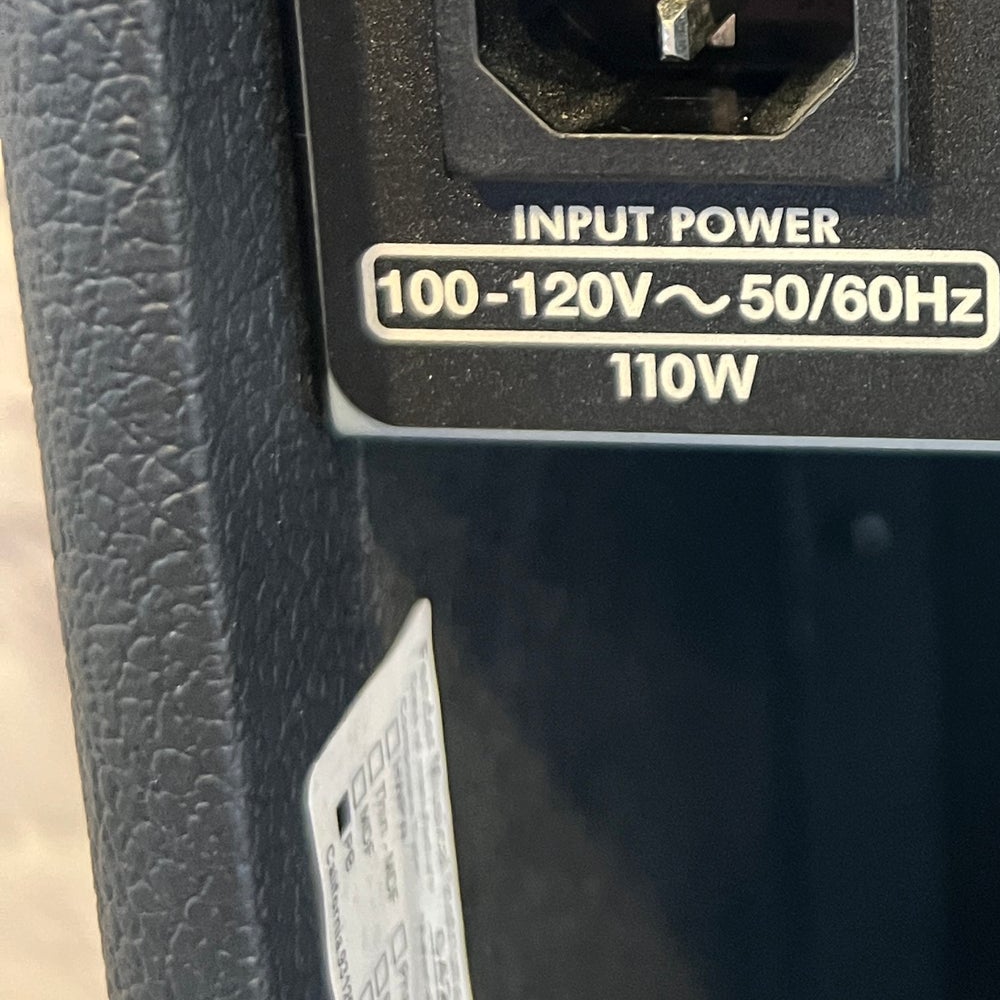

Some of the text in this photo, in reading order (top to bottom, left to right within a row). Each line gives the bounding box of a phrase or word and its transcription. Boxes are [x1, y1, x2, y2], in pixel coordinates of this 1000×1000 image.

[514, 204, 840, 244] INPUT POWER
[609, 352, 758, 402] 110W
